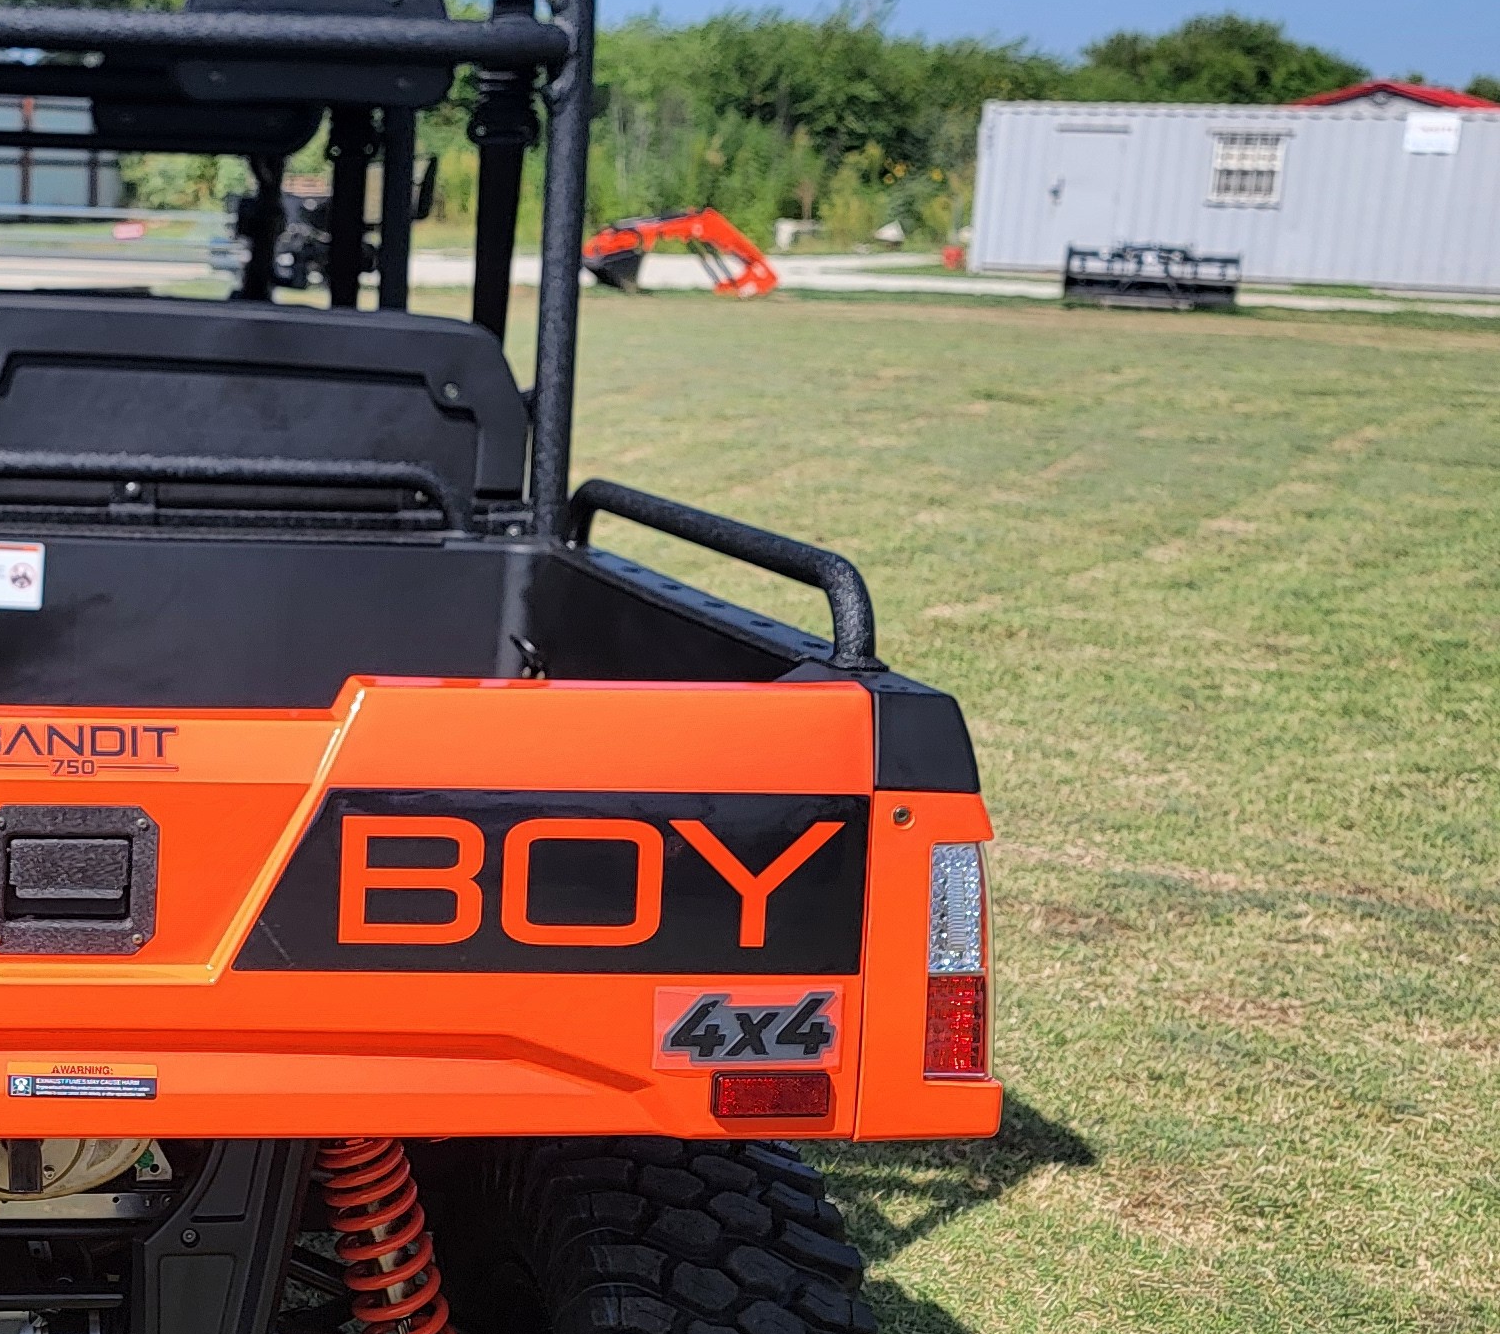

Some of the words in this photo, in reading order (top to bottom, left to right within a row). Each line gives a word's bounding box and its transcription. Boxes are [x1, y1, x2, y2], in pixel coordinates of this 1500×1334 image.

[51, 759, 95, 775] 750
[337, 815, 847, 948] BOY
[669, 996, 832, 1058] 4x4
[60, 1065, 114, 1075] WARNING:
